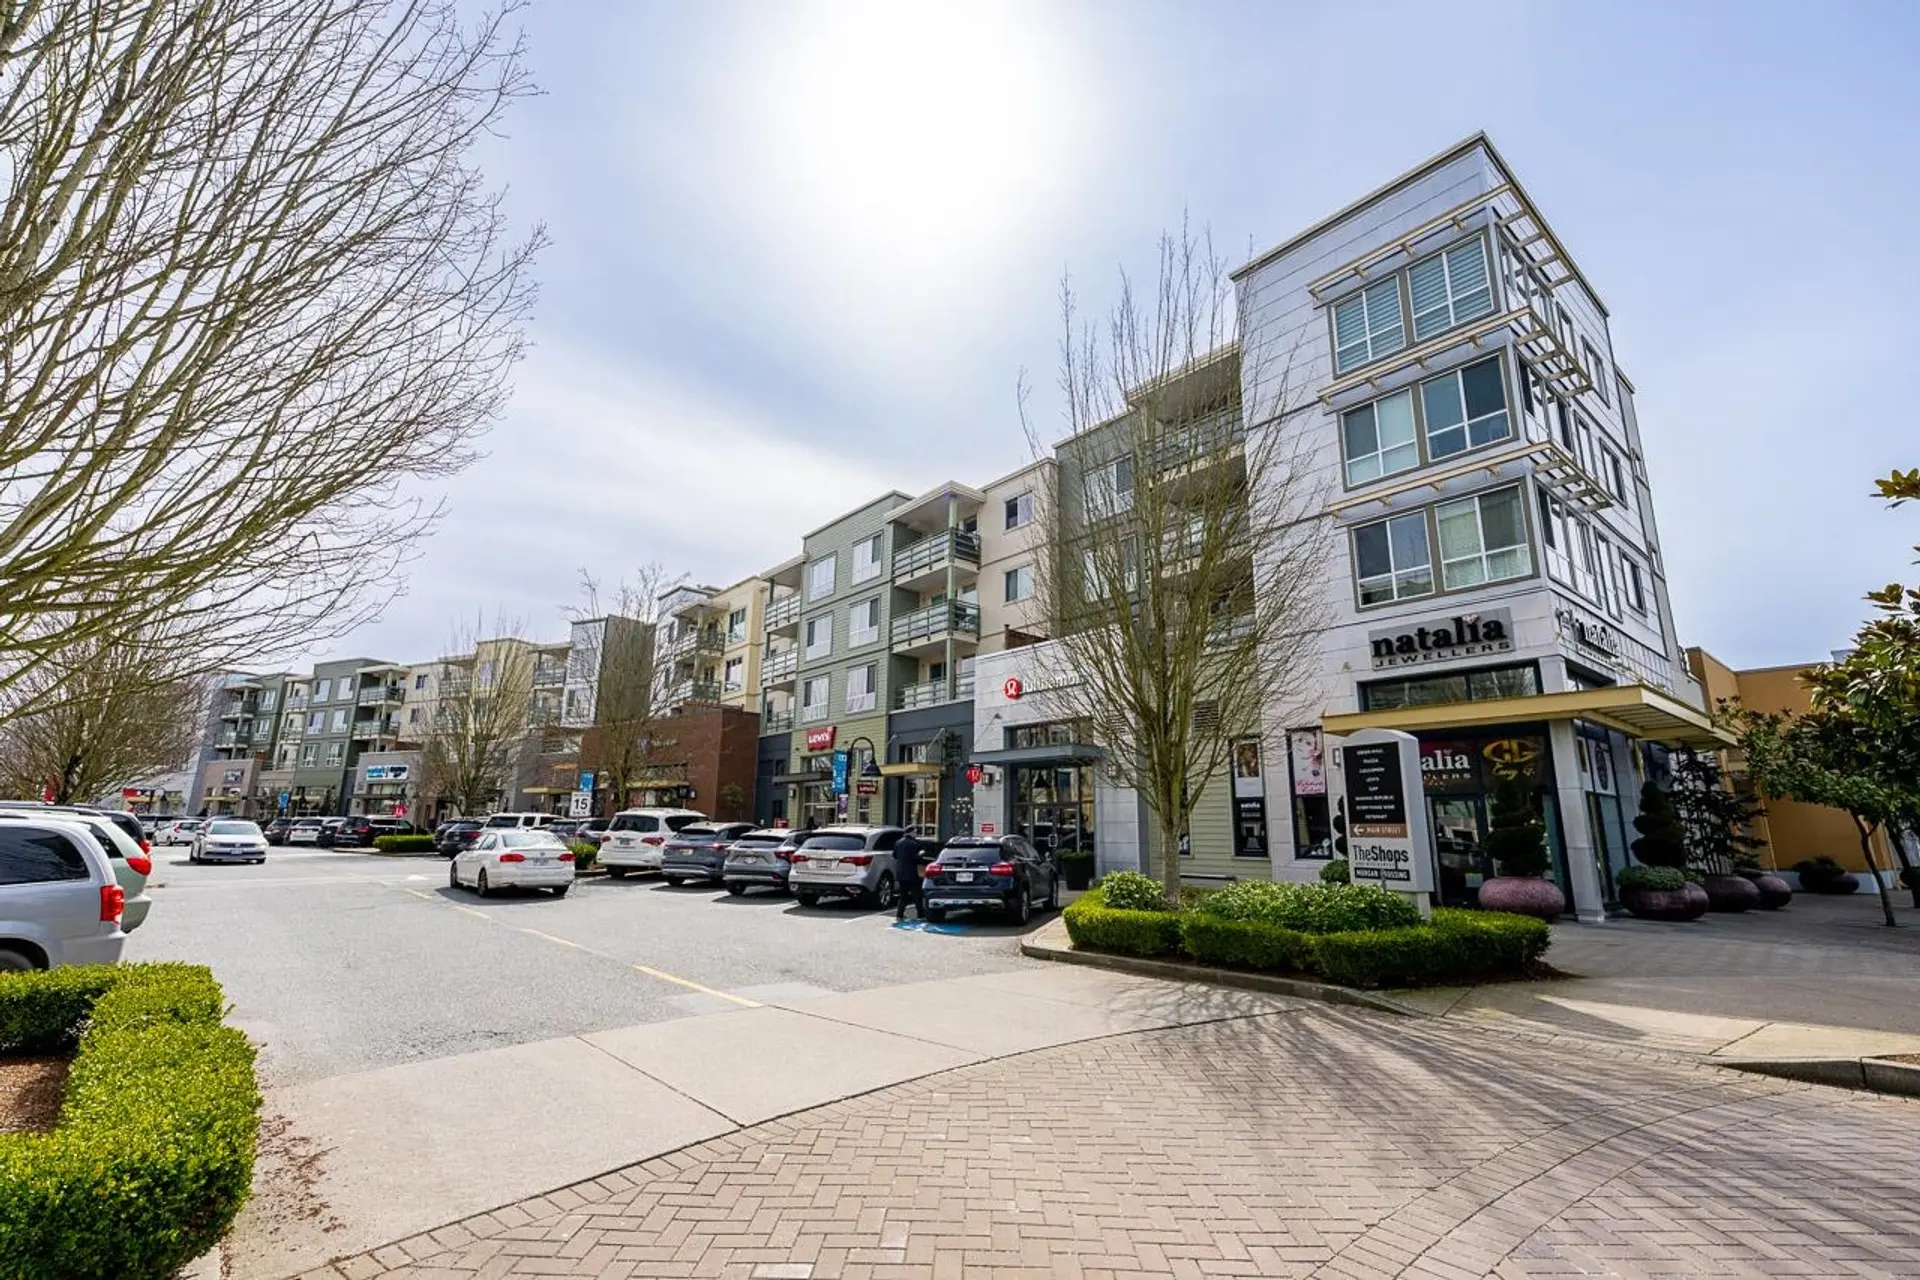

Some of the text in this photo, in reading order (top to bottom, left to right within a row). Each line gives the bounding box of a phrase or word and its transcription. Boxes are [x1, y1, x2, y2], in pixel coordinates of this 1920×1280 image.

[1369, 616, 1508, 657] natalia
[1375, 641, 1510, 667] JEWELLERS
[1421, 749, 1471, 771] alia
[575, 798, 588, 810] 15
[1352, 845, 1409, 869] TheShops
